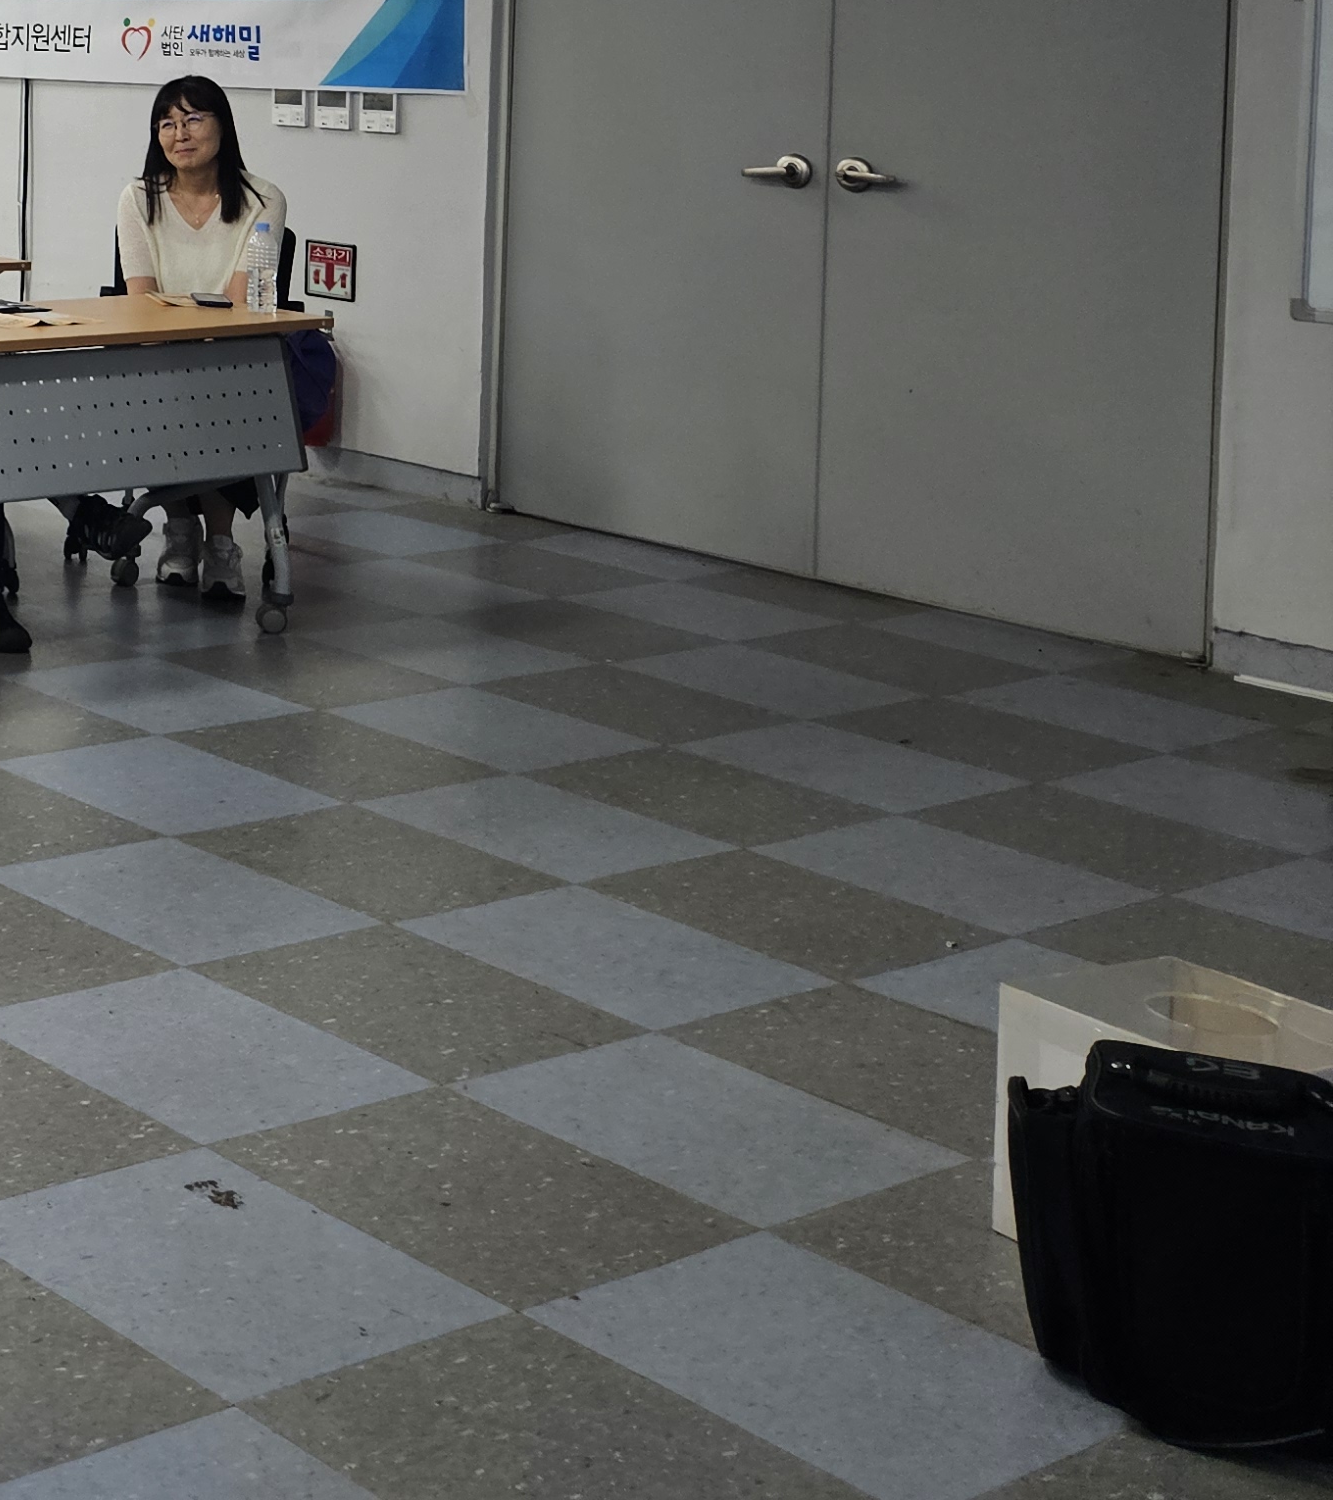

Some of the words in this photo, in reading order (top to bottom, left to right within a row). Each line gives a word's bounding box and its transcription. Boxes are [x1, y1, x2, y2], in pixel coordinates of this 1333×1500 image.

[161, 25, 184, 40] 사단
[161, 41, 184, 57] 법인
[187, 24, 262, 62] 새해밀
[311, 247, 350, 263] 소화기
